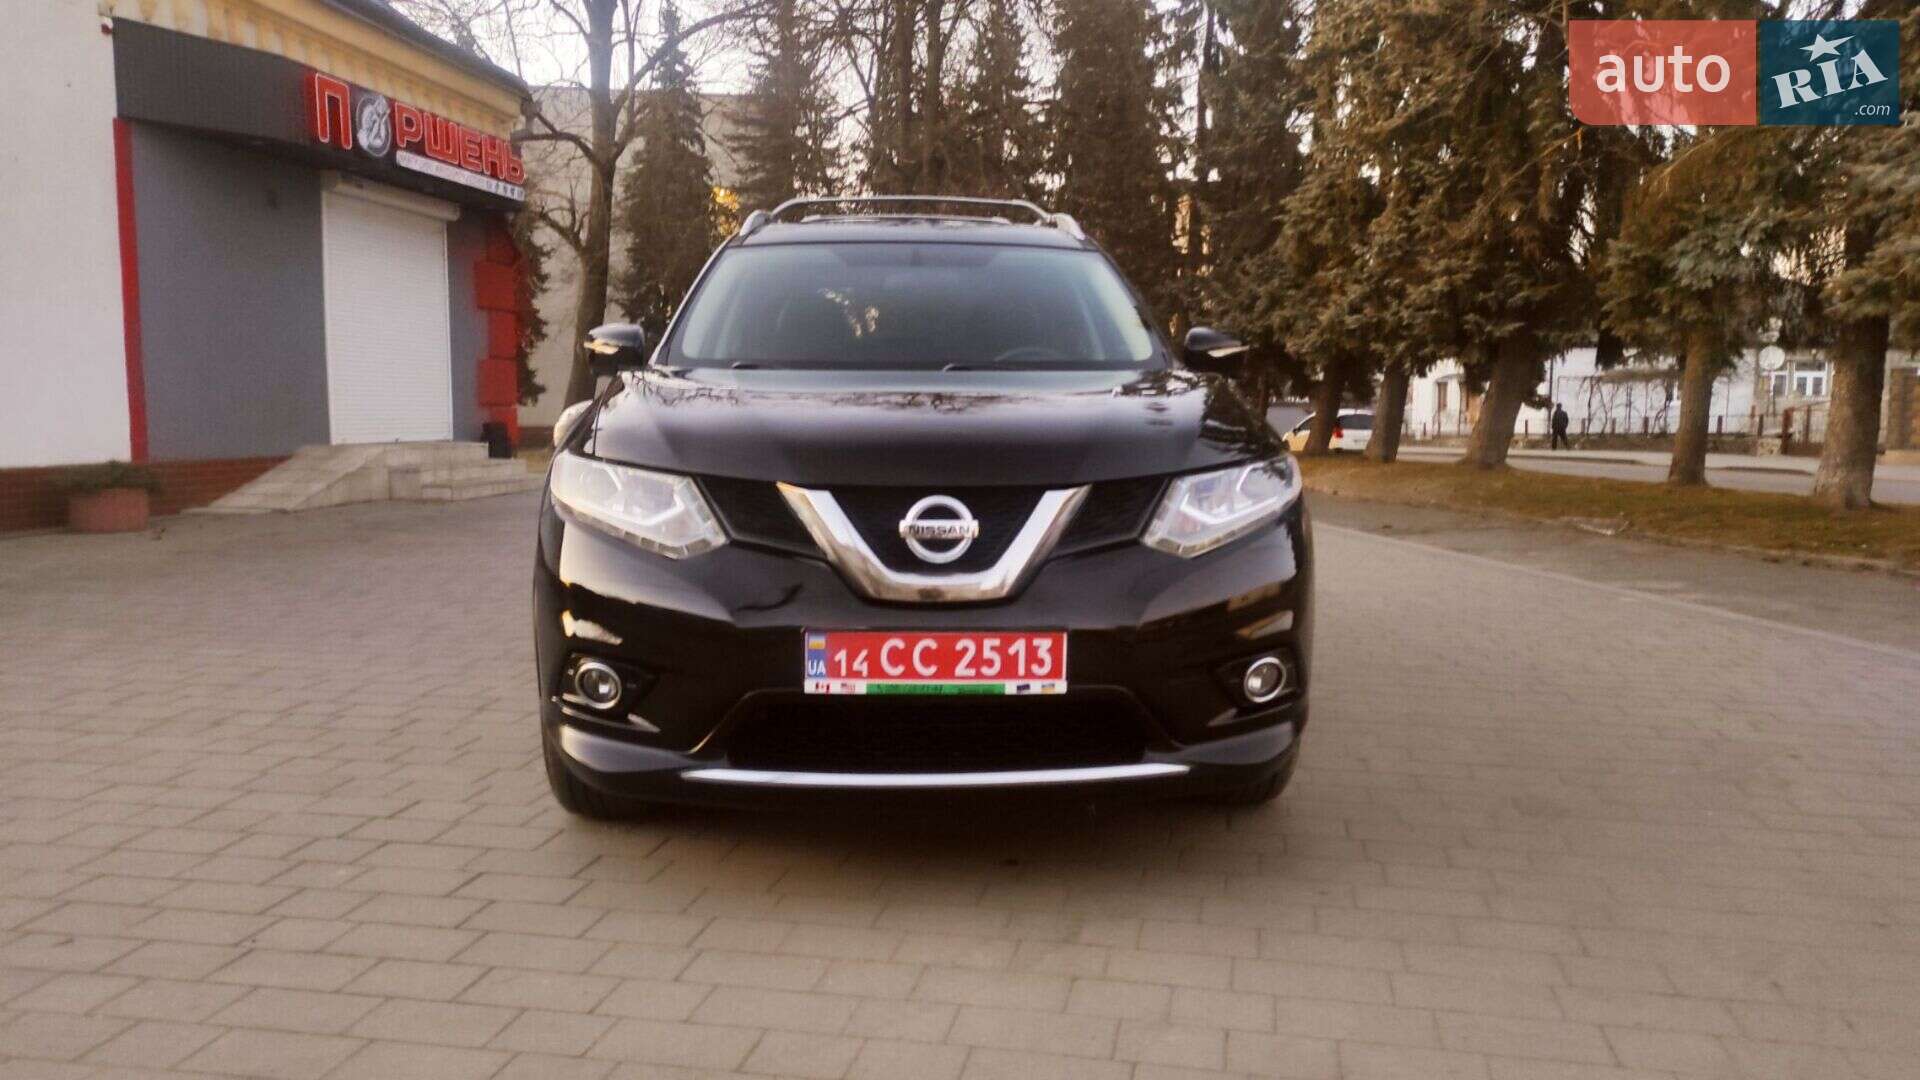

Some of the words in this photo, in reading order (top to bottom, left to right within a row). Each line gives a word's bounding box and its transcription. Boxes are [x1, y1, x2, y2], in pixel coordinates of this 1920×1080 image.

[908, 524, 970, 536] NISSAN
[834, 649, 868, 677] 14
[880, 638, 938, 677] CC
[955, 638, 1053, 677] 2513
[808, 659, 826, 675] UA
